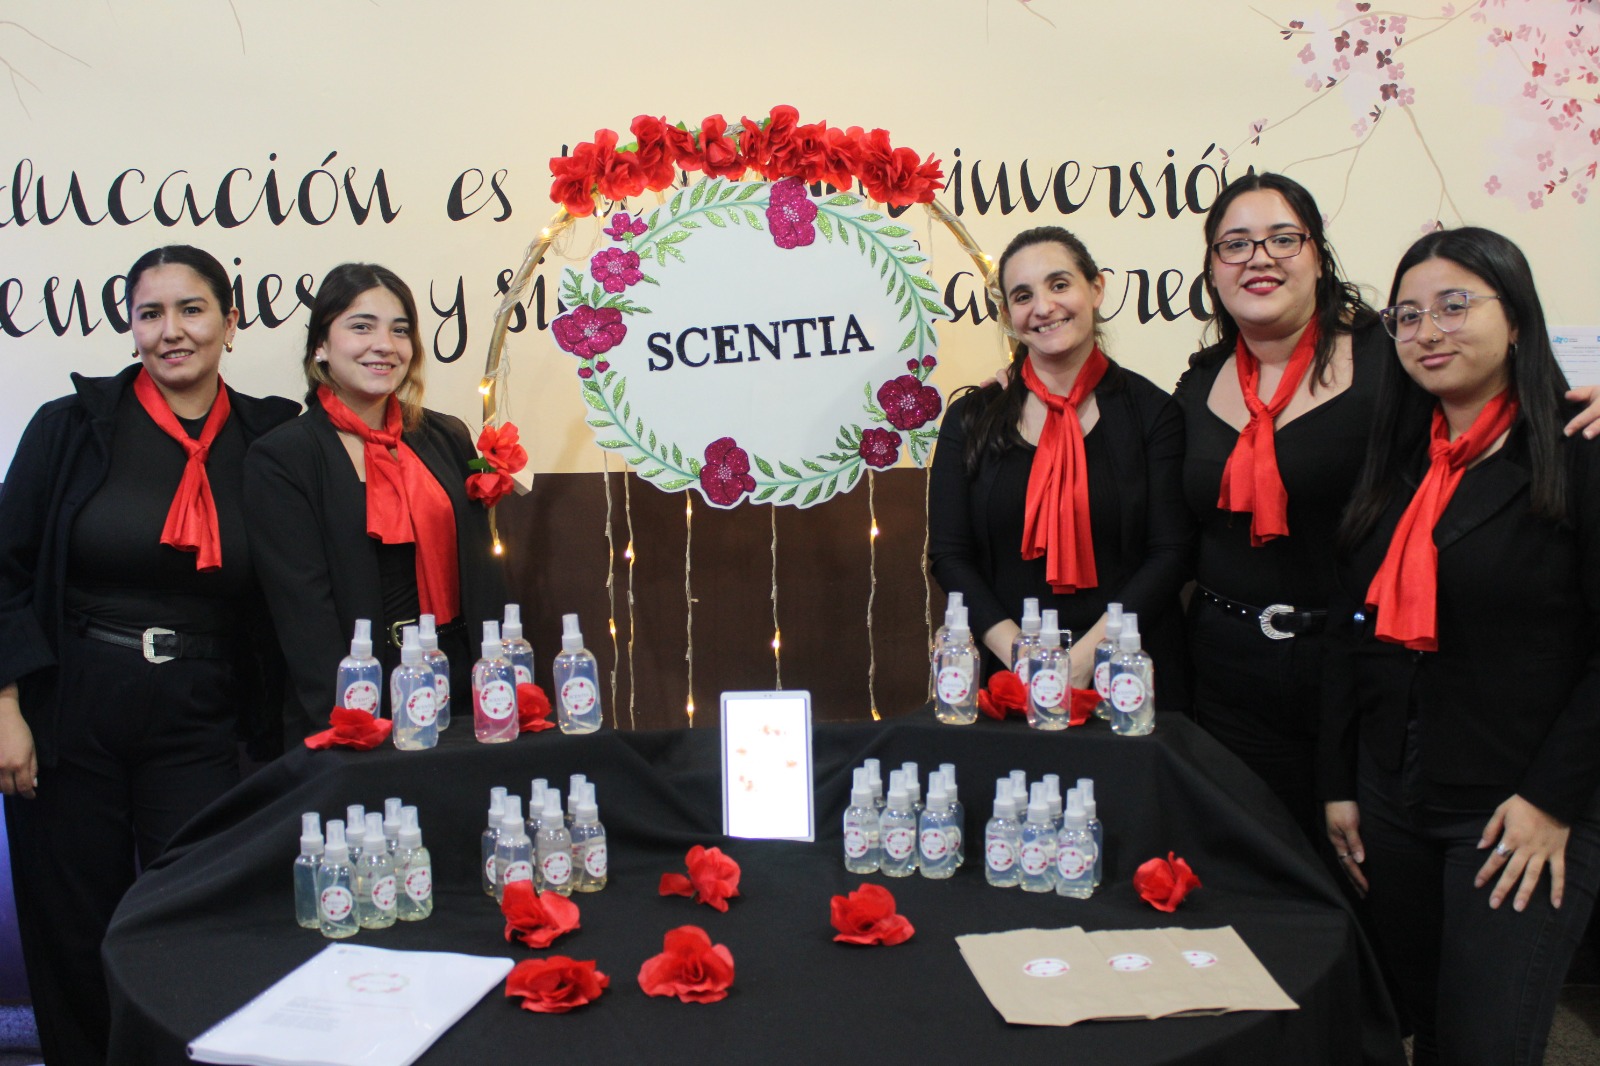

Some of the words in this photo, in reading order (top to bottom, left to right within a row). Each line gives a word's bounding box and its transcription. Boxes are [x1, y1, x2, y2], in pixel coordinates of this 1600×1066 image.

[446, 167, 512, 222] es
[943, 143, 1255, 220] inversió
[429, 275, 468, 364] y
[646, 313, 875, 372] SCENTIA
